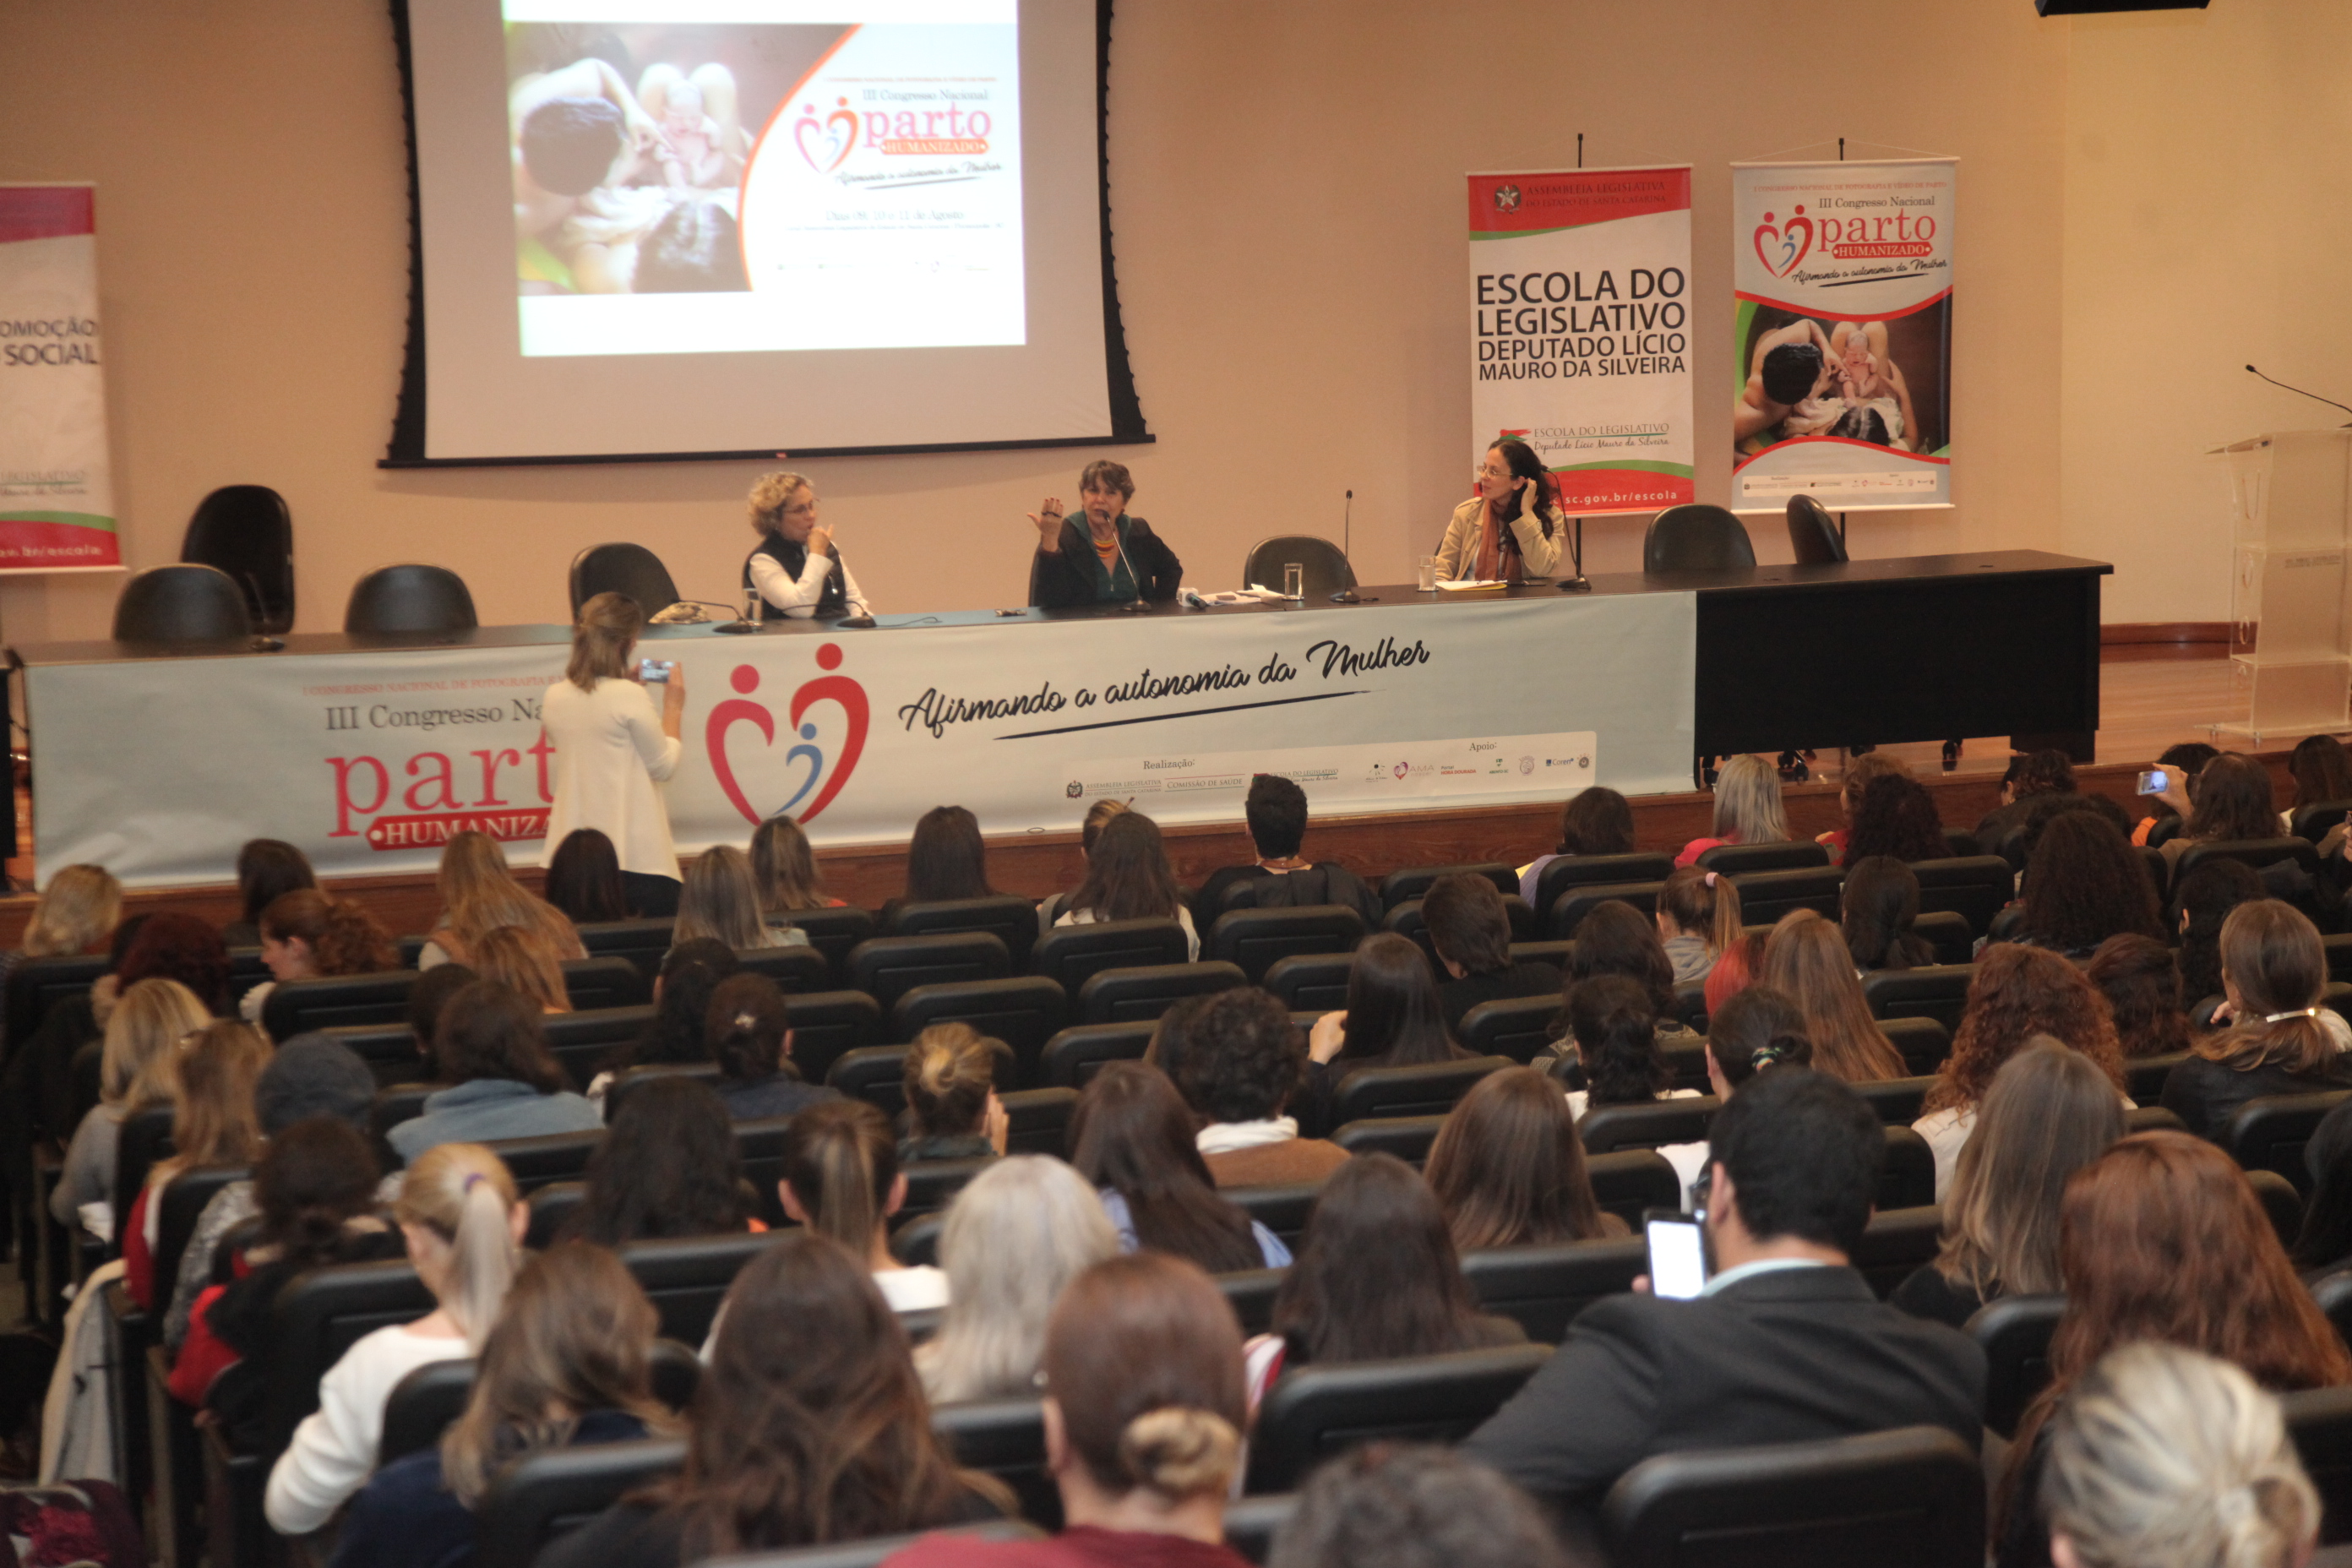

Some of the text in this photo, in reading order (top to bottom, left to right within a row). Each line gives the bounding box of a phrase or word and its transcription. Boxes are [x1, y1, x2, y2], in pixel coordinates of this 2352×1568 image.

[863, 89, 988, 102] III Congresso Nacional
[862, 101, 992, 148] parto
[887, 141, 980, 154] HUMANIZADO
[1527, 181, 1666, 195] ASSEMBLEIA LEGISLATIVA
[1592, 197, 1620, 205] SANTA
[1622, 195, 1666, 204] CATARINA
[1819, 196, 1935, 210] III Congresso Nacional
[1817, 208, 1936, 253] parto
[1838, 244, 1925, 257] HUMANIZADO
[1792, 269, 1840, 286] Afirmando
[1851, 265, 1894, 277] autonomia
[1896, 263, 1908, 272] da
[1910, 259, 1947, 270] Mulher
[1478, 267, 1685, 305] ESCOLA DO
[0, 316, 96, 339] OMOÇÃO
[1478, 302, 1685, 336] LEGISLATIVO
[3, 343, 98, 366] SOCIAL
[1478, 330, 1685, 362] DEPUTADO LÍCIO
[1479, 356, 1685, 380] MAURO DA SILVEIRA
[1534, 423, 1669, 438] ESCOLA DO LEGISLATIVO
[1534, 439, 1572, 455] Deputado
[1596, 438, 1623, 449] Mauro
[1625, 437, 1636, 446] da
[1638, 436, 1669, 446] Silveira
[898, 636, 1430, 739] Afirmando a autonomia da Mulher
[324, 706, 359, 730] III
[369, 704, 503, 731] Congresso
[1469, 741, 1497, 752] Apoio:
[1143, 759, 1195, 770] Realização:
[324, 724, 557, 837] part
[1167, 780, 1206, 789] COMISSÃO
[1219, 777, 1243, 786] SAÚDE
[384, 814, 552, 845] HUMANIZA
